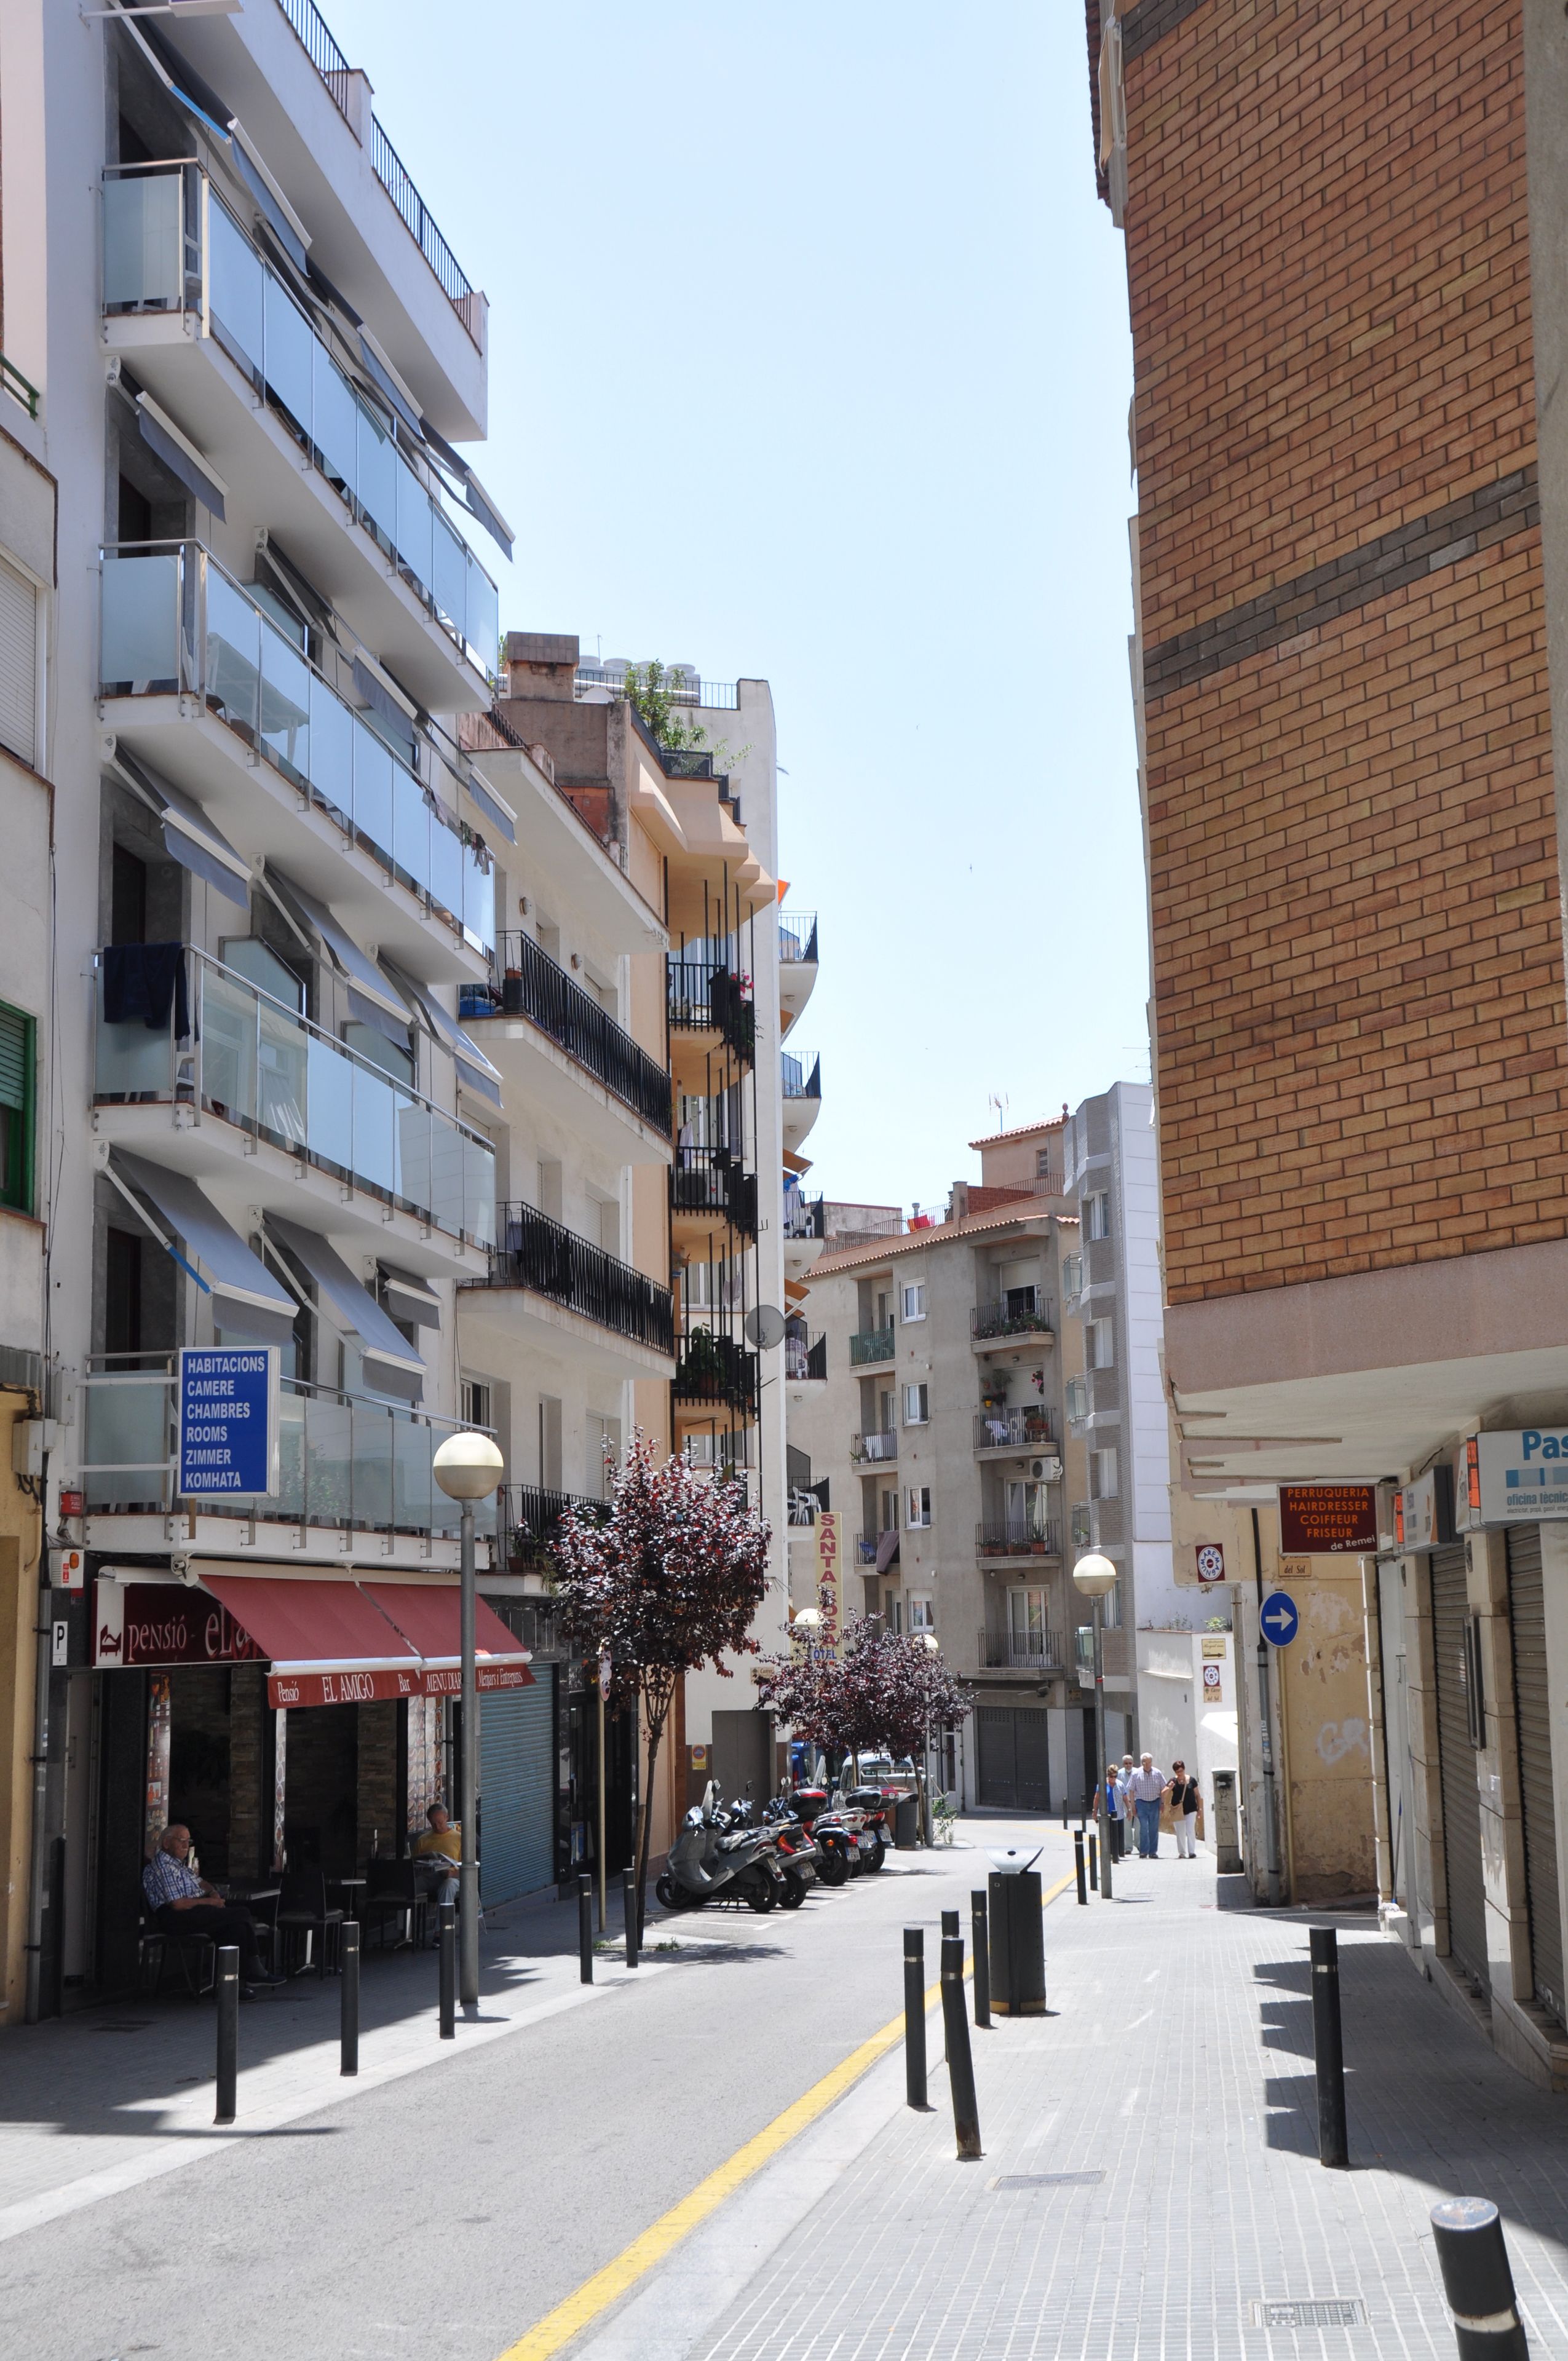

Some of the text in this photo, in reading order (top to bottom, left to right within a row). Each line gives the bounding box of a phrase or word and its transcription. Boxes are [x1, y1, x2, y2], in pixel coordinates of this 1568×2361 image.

[188, 1356, 265, 1374] HABITACIONS
[187, 1380, 235, 1396] CAMERE
[187, 1402, 250, 1419] CHAMBRES
[186, 1426, 228, 1442] ROOMS
[186, 1449, 231, 1465] ZIMMER
[1288, 1488, 1369, 1498] PERRUQUERIA
[1507, 1493, 1537, 1506] oficina
[1289, 1501, 1368, 1511] HAIRDRESSER
[1300, 1514, 1358, 1524] COIFFEUR
[1307, 1529, 1353, 1537] FRISEUR
[820, 1514, 837, 1583] SANTA
[1345, 1535, 1376, 1548] Remei
[57, 1625, 65, 1650] P
[812, 1649, 837, 1659] OTEL
[277, 1674, 411, 1703] Pensió EL AMIGO Bar
[426, 1673, 447, 1692] MENU
[448, 1672, 462, 1690] DIAR
